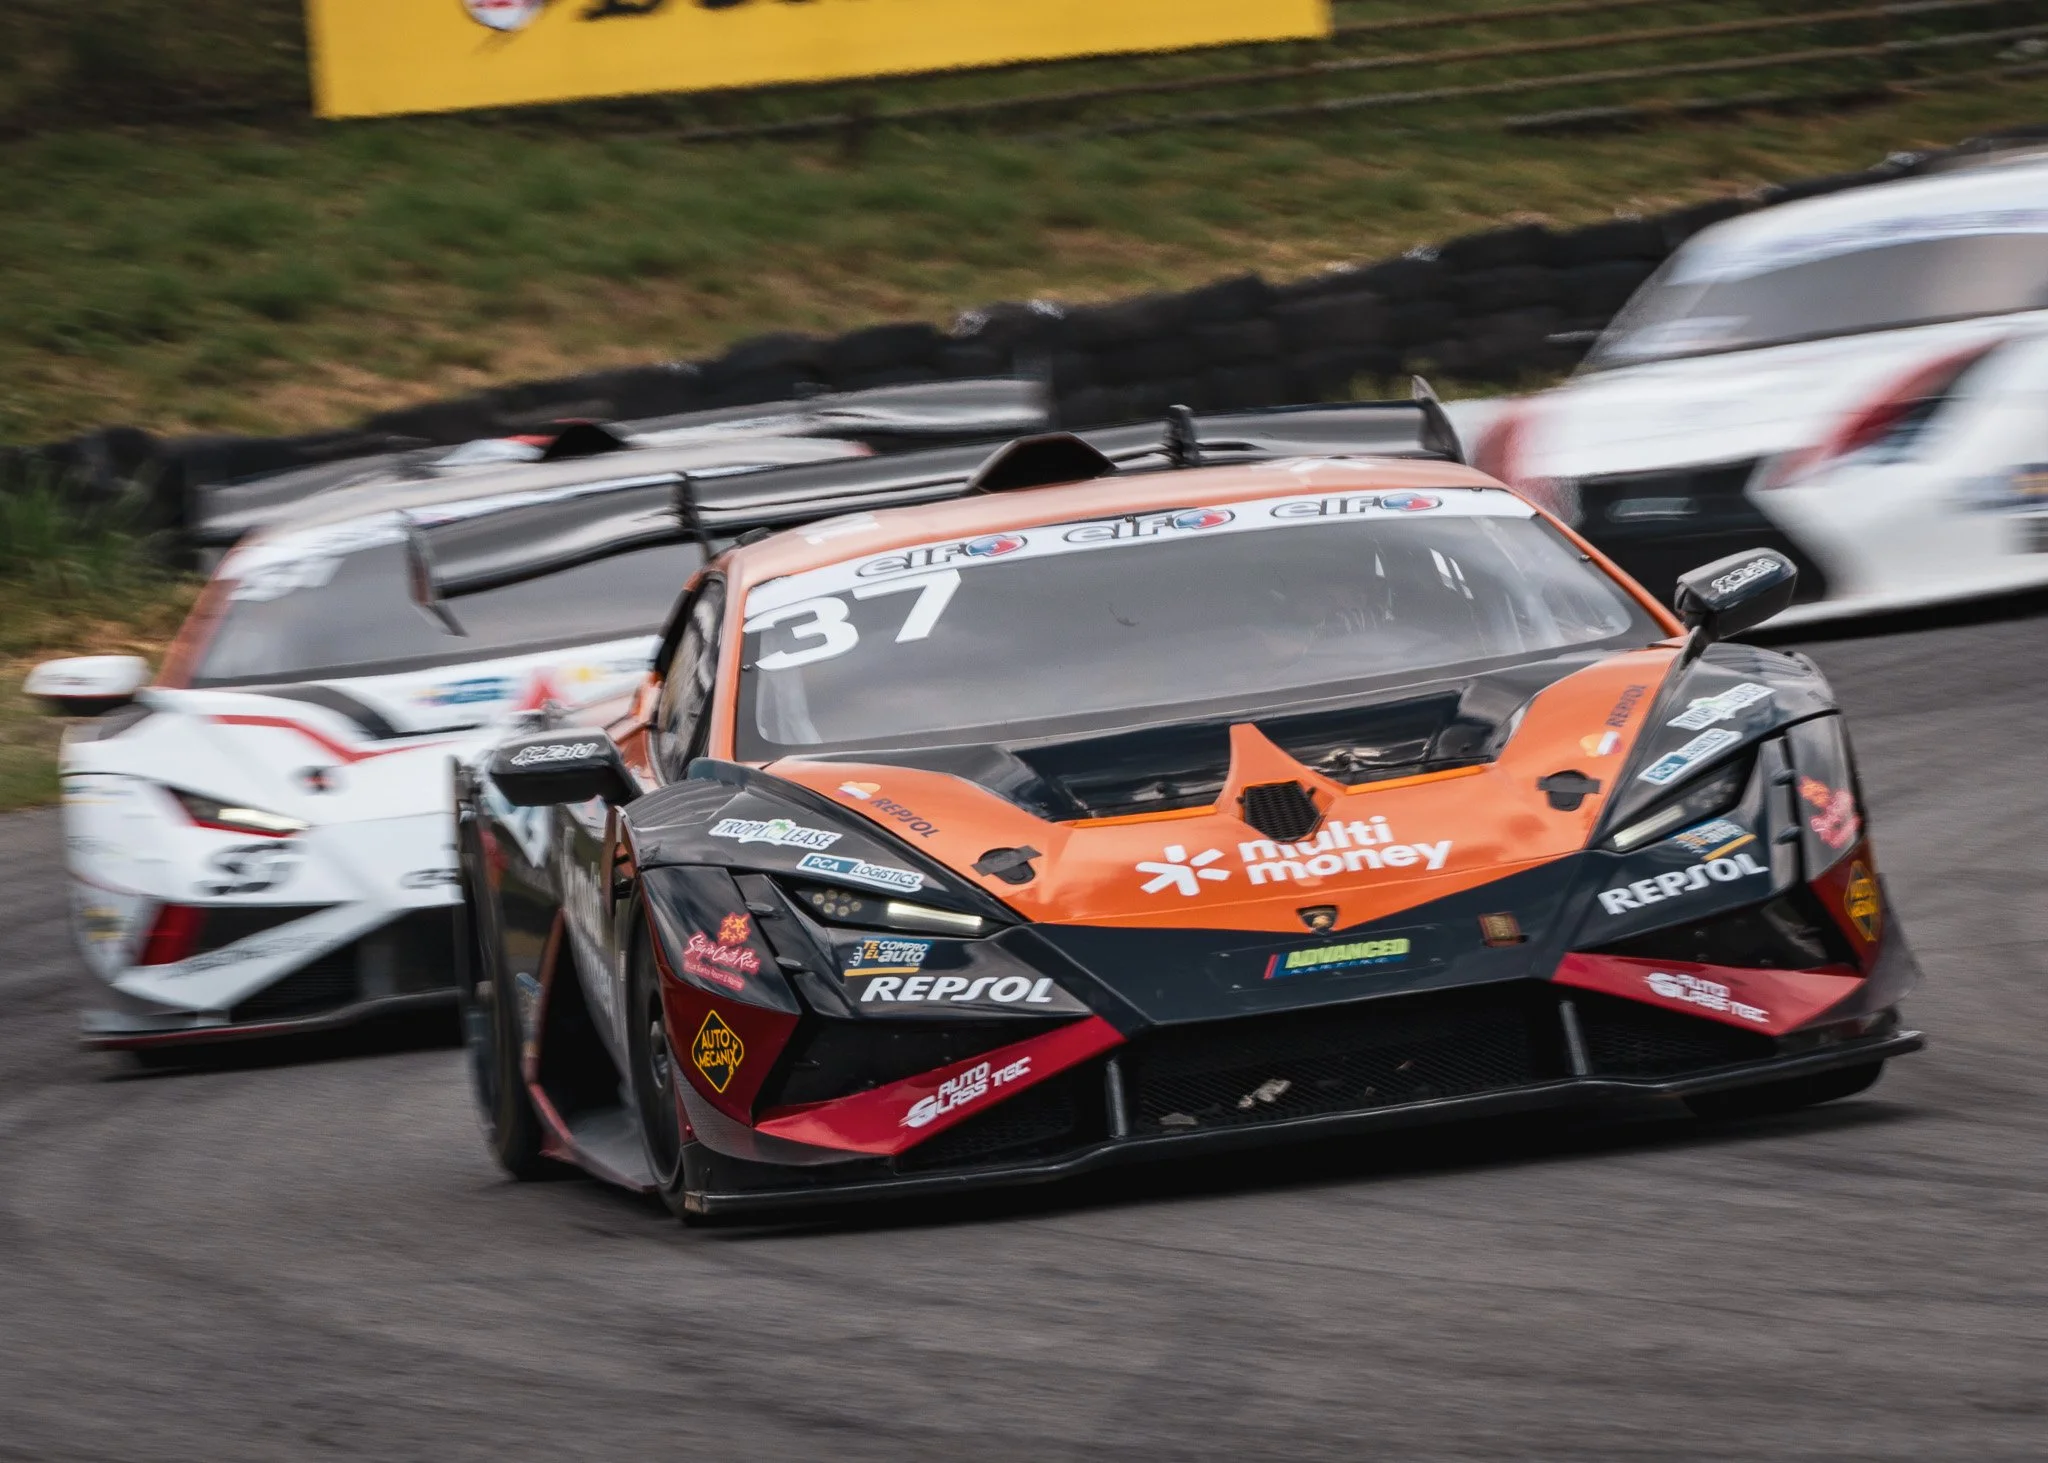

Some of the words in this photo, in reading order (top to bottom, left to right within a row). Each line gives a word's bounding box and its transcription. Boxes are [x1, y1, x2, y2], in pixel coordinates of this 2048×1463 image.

[1270, 495, 1382, 518] elf
[855, 543, 967, 577] elf
[742, 568, 961, 671] 37
[869, 798, 940, 838] REPSOL
[1238, 815, 1394, 863] multi
[808, 857, 840, 872] PCA
[852, 863, 920, 886] LOGISTICS
[1246, 840, 1453, 886] money
[1597, 853, 1770, 915] REPSOL
[864, 940, 880, 950] TE
[879, 940, 930, 952] COMPRO
[864, 949, 880, 959] EL
[878, 950, 925, 963] auto
[860, 976, 1054, 1002] REPSOL
[701, 1028, 730, 1050] AUTO
[938, 1061, 991, 1096] AUTO
[991, 1056, 1032, 1087] TEC
